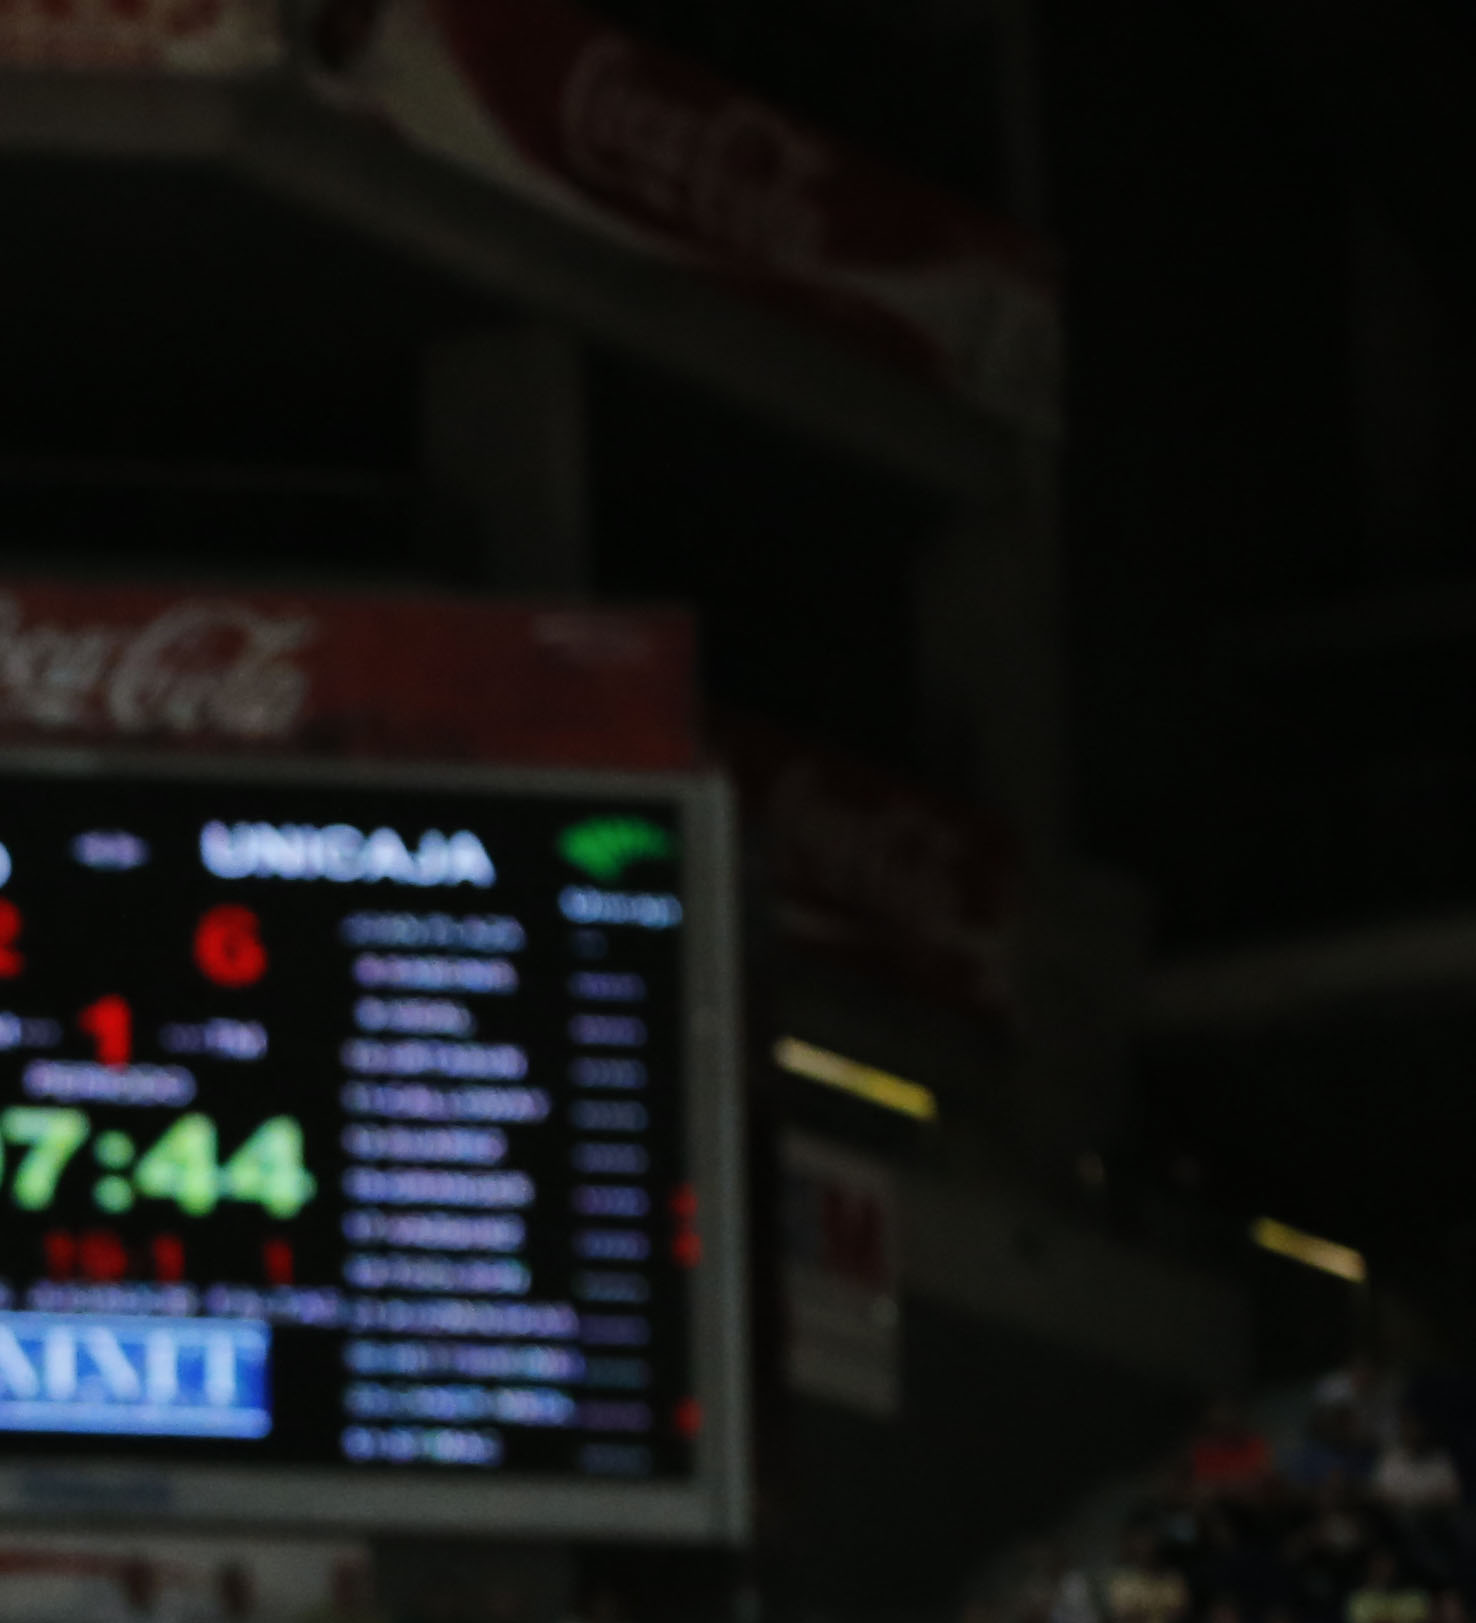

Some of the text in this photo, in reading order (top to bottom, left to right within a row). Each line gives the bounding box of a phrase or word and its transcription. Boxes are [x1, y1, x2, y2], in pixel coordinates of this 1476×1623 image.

[200, 820, 495, 888] UNICAJA
[194, 904, 268, 988] 6
[79, 994, 134, 1068] 1
